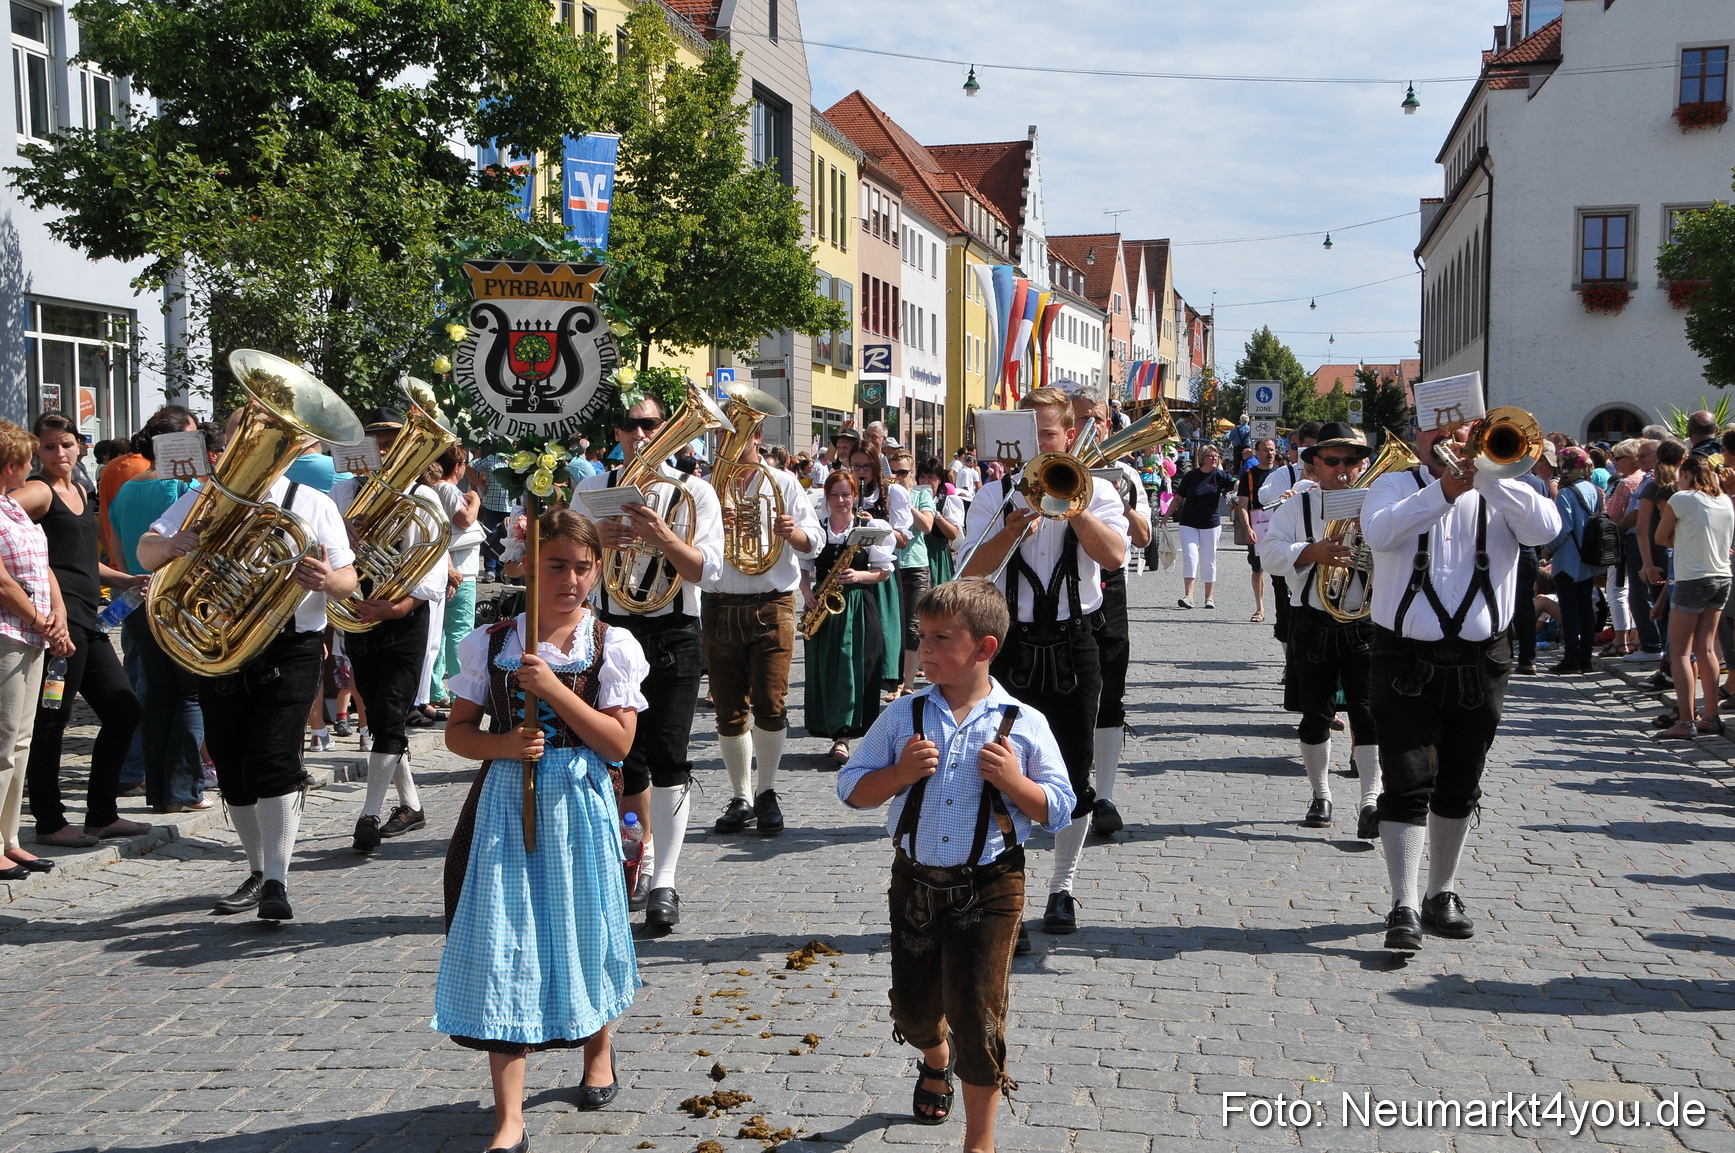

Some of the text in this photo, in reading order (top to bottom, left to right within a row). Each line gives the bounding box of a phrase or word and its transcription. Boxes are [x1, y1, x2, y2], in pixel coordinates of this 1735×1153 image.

[484, 278, 584, 298] PYRBAUM
[747, 358, 784, 366] runnwirtsgasse
[505, 418, 537, 439] DER
